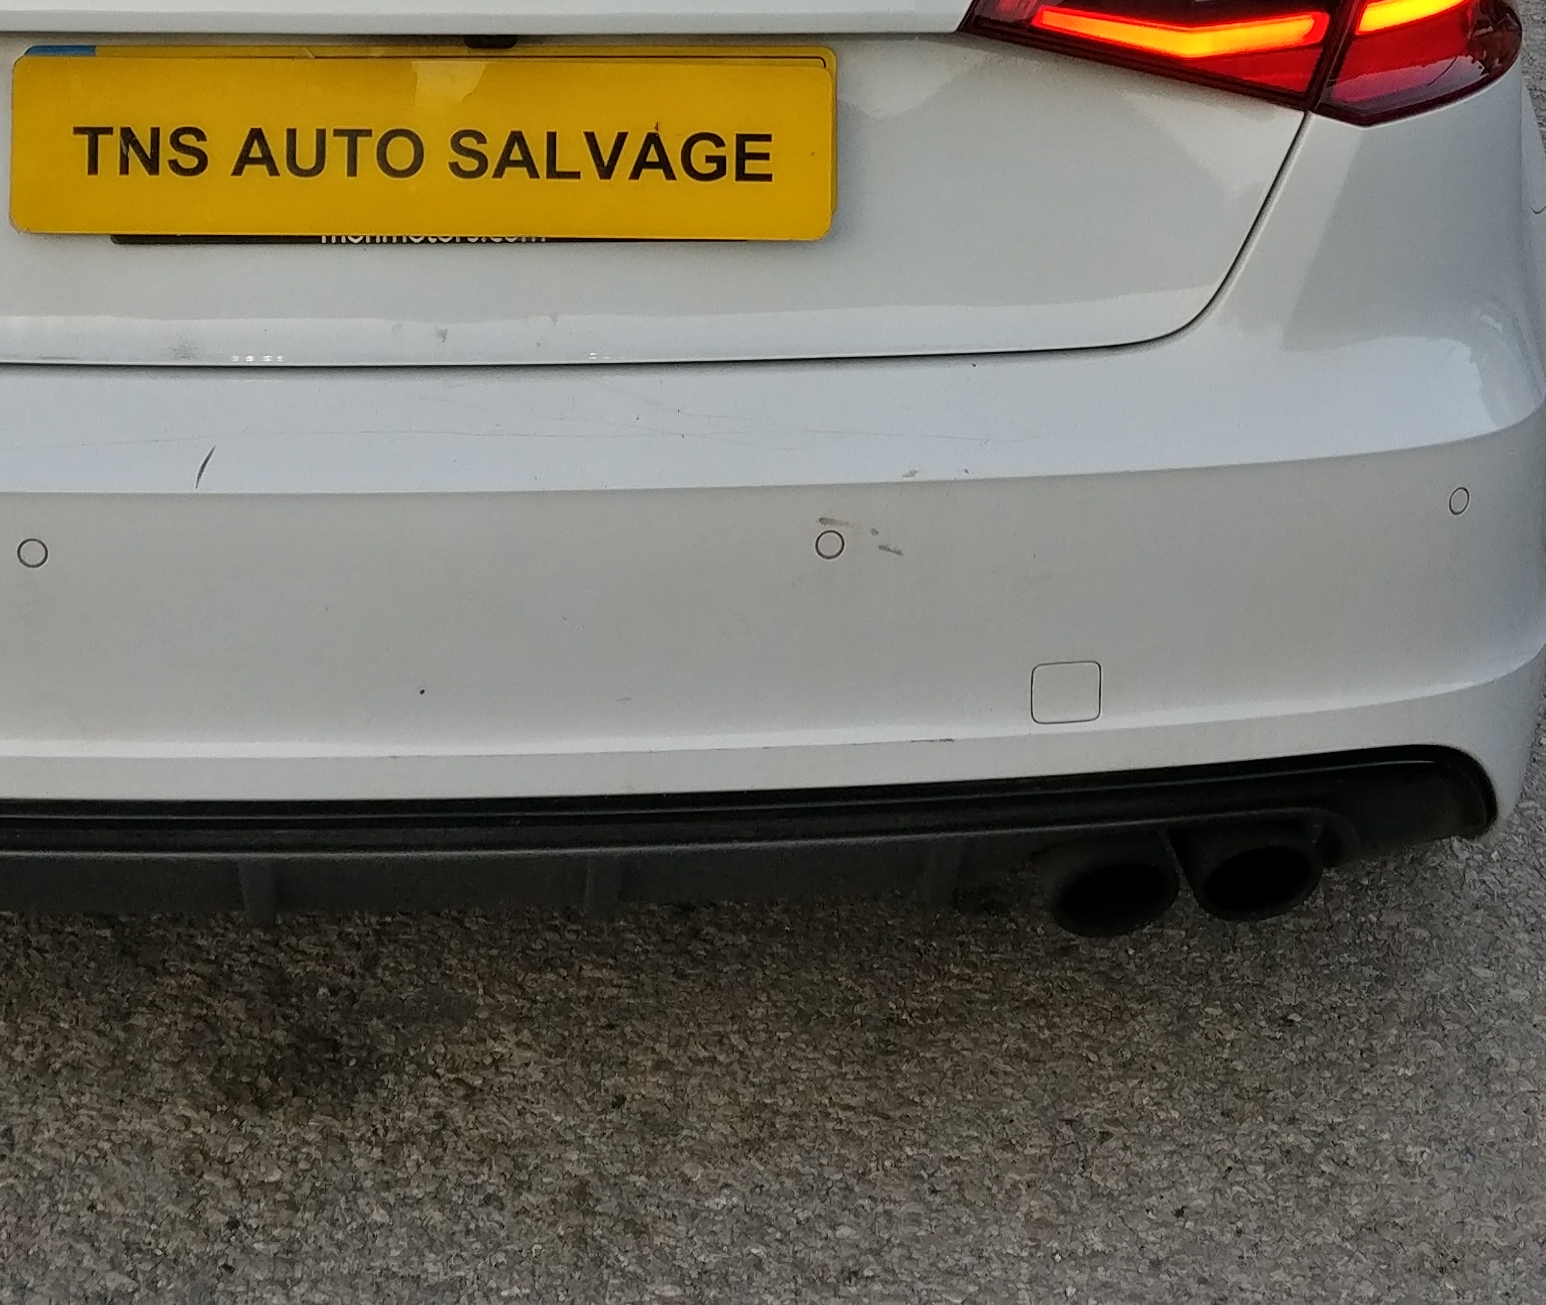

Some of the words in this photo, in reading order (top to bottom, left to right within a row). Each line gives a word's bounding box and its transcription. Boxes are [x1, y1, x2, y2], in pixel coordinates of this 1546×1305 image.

[72, 125, 209, 177] TNS
[230, 127, 426, 179] AUTO
[447, 129, 774, 183] SALVAGE
